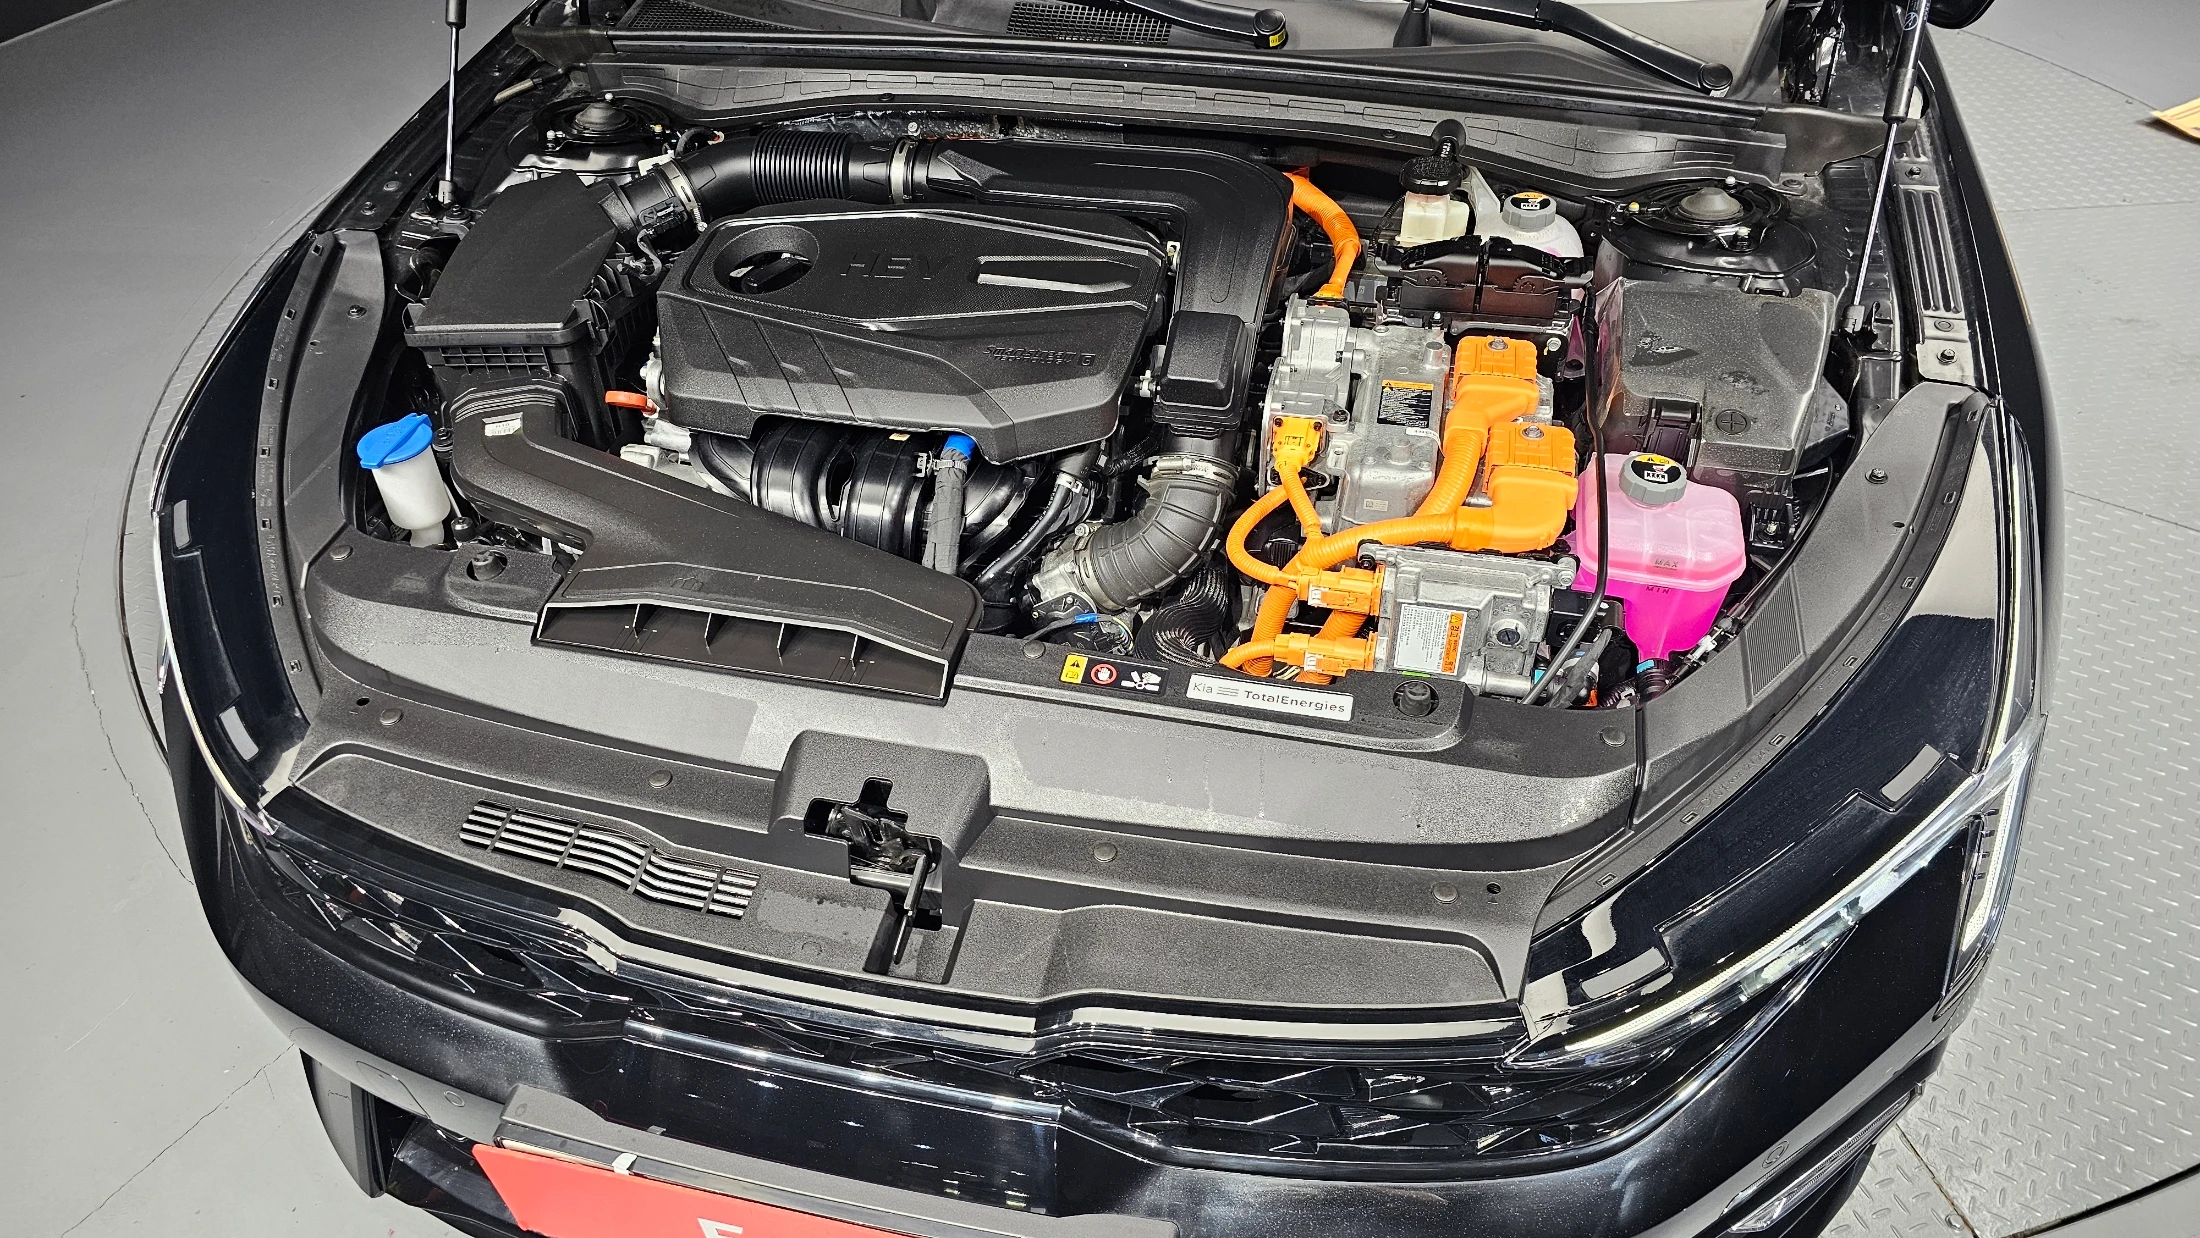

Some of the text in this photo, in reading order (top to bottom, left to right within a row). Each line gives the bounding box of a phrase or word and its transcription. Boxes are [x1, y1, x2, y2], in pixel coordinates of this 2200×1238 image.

[840, 252, 954, 280] HEV
[1654, 558, 1679, 568] MAX
[1646, 586, 1671, 594] MIN
[1193, 681, 1345, 713] Kia TotalEnergies
